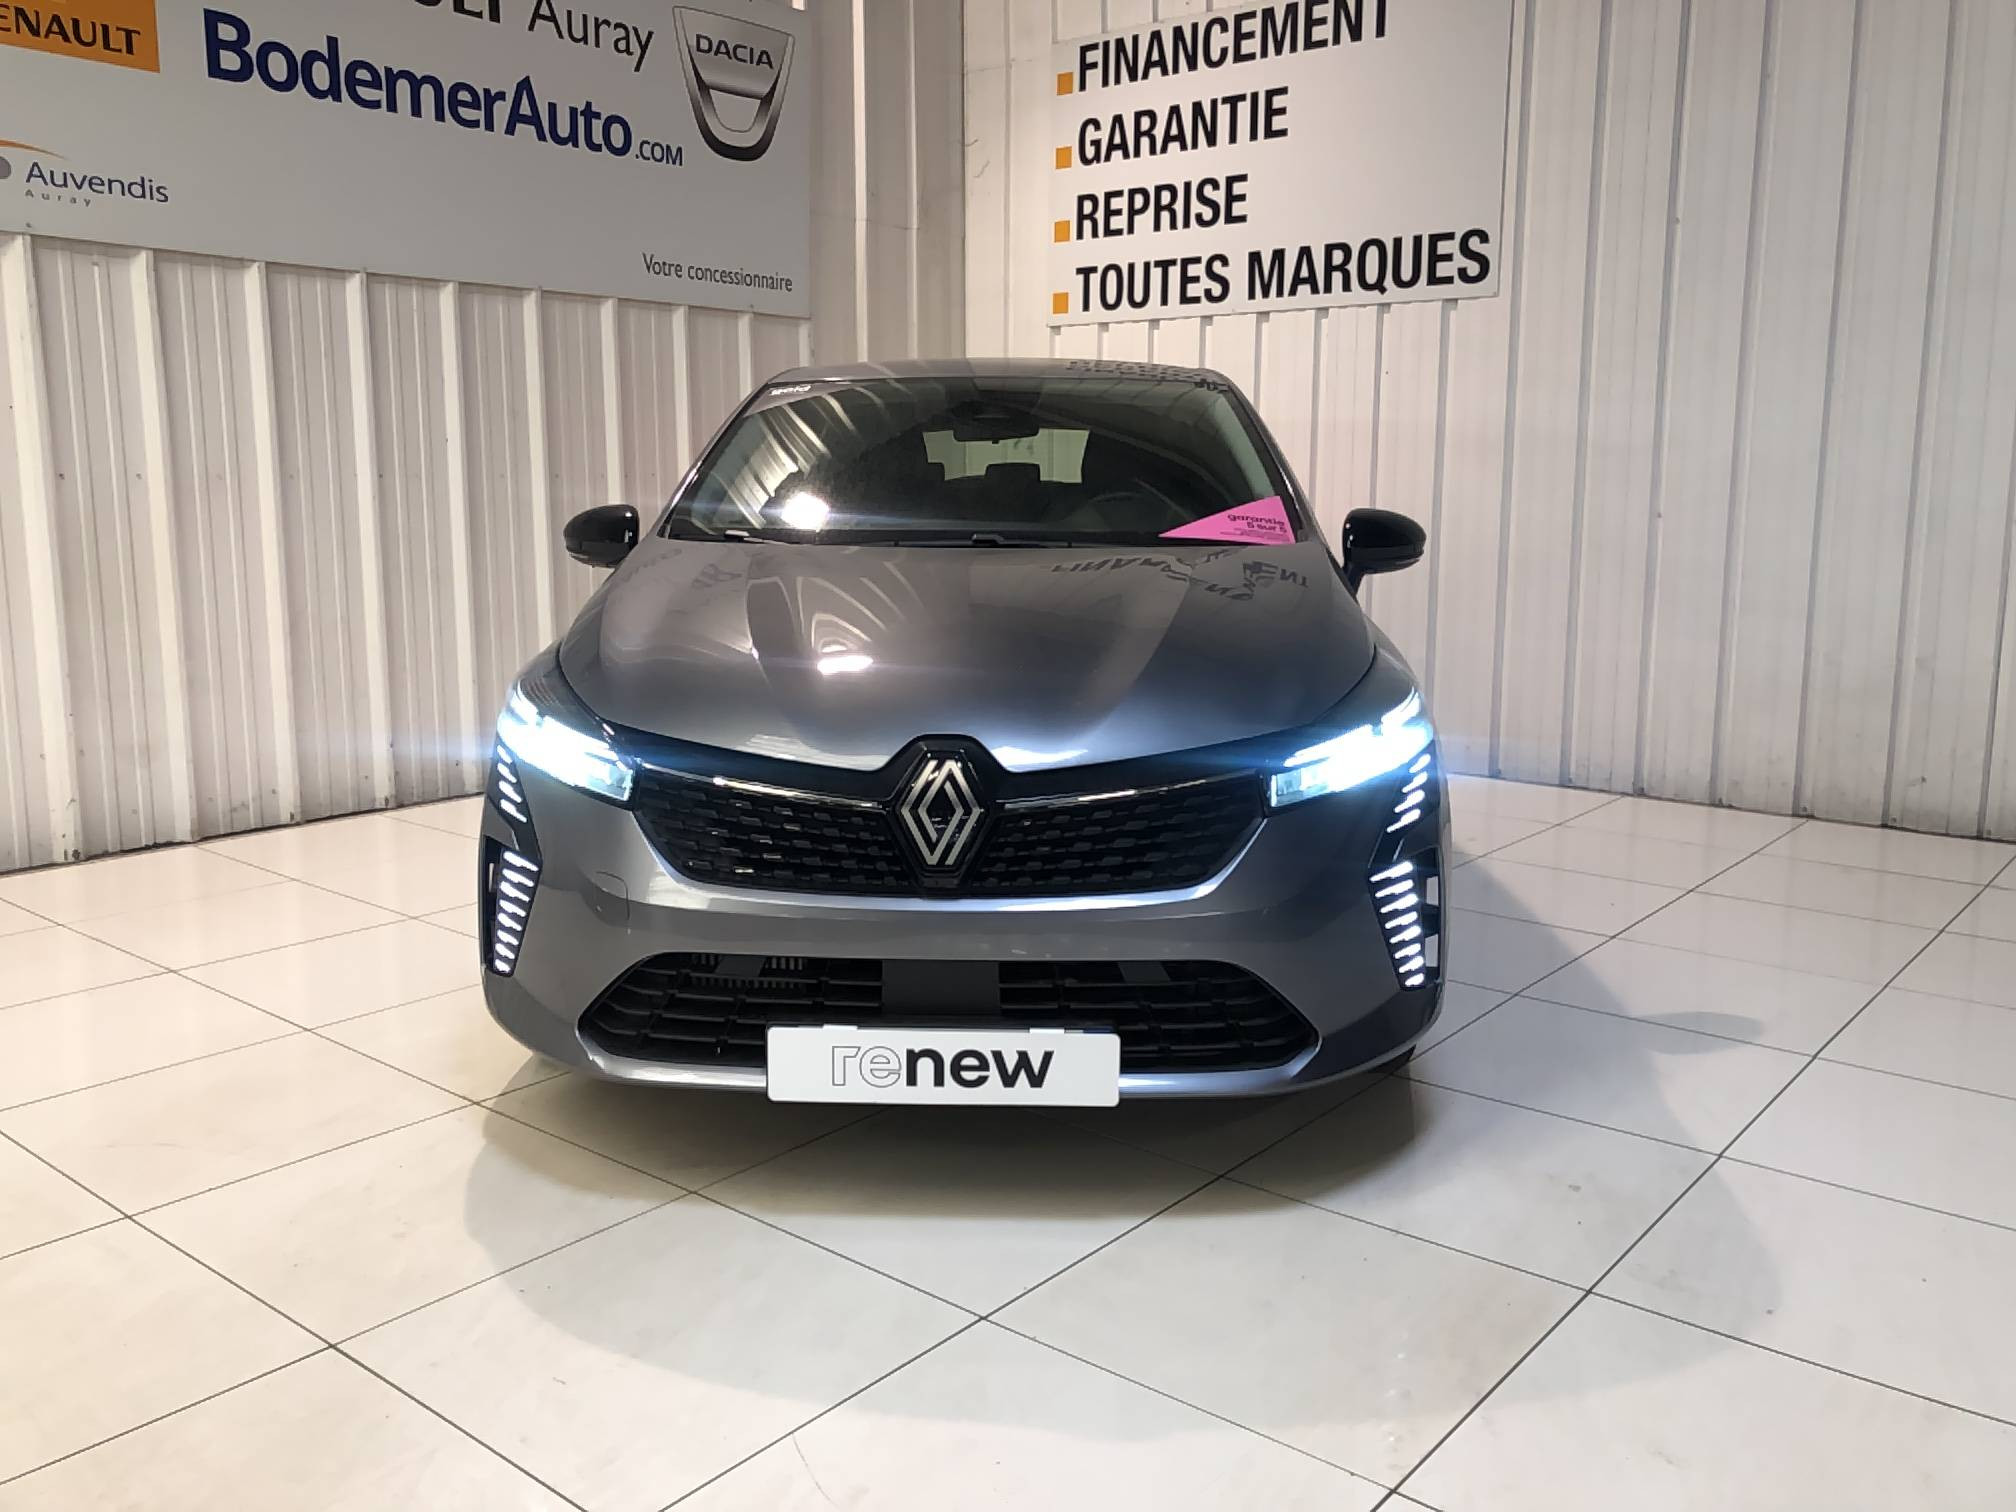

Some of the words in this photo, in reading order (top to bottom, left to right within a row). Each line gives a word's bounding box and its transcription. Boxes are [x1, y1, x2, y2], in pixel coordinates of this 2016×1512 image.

[527, 0, 654, 72] Auray
[695, 33, 774, 70] DACIA
[1077, 86, 1289, 166] GARANTIE
[24, 189, 92, 207] Auray
[25, 161, 169, 203] Auvendis
[1076, 173, 1248, 241] REPRISE
[642, 252, 683, 278] Votre
[687, 264, 793, 292] concessionnaire
[1075, 253, 1230, 313] TOUTES
[1247, 228, 1492, 301] MARQUES
[831, 1045, 1055, 1089] renew
